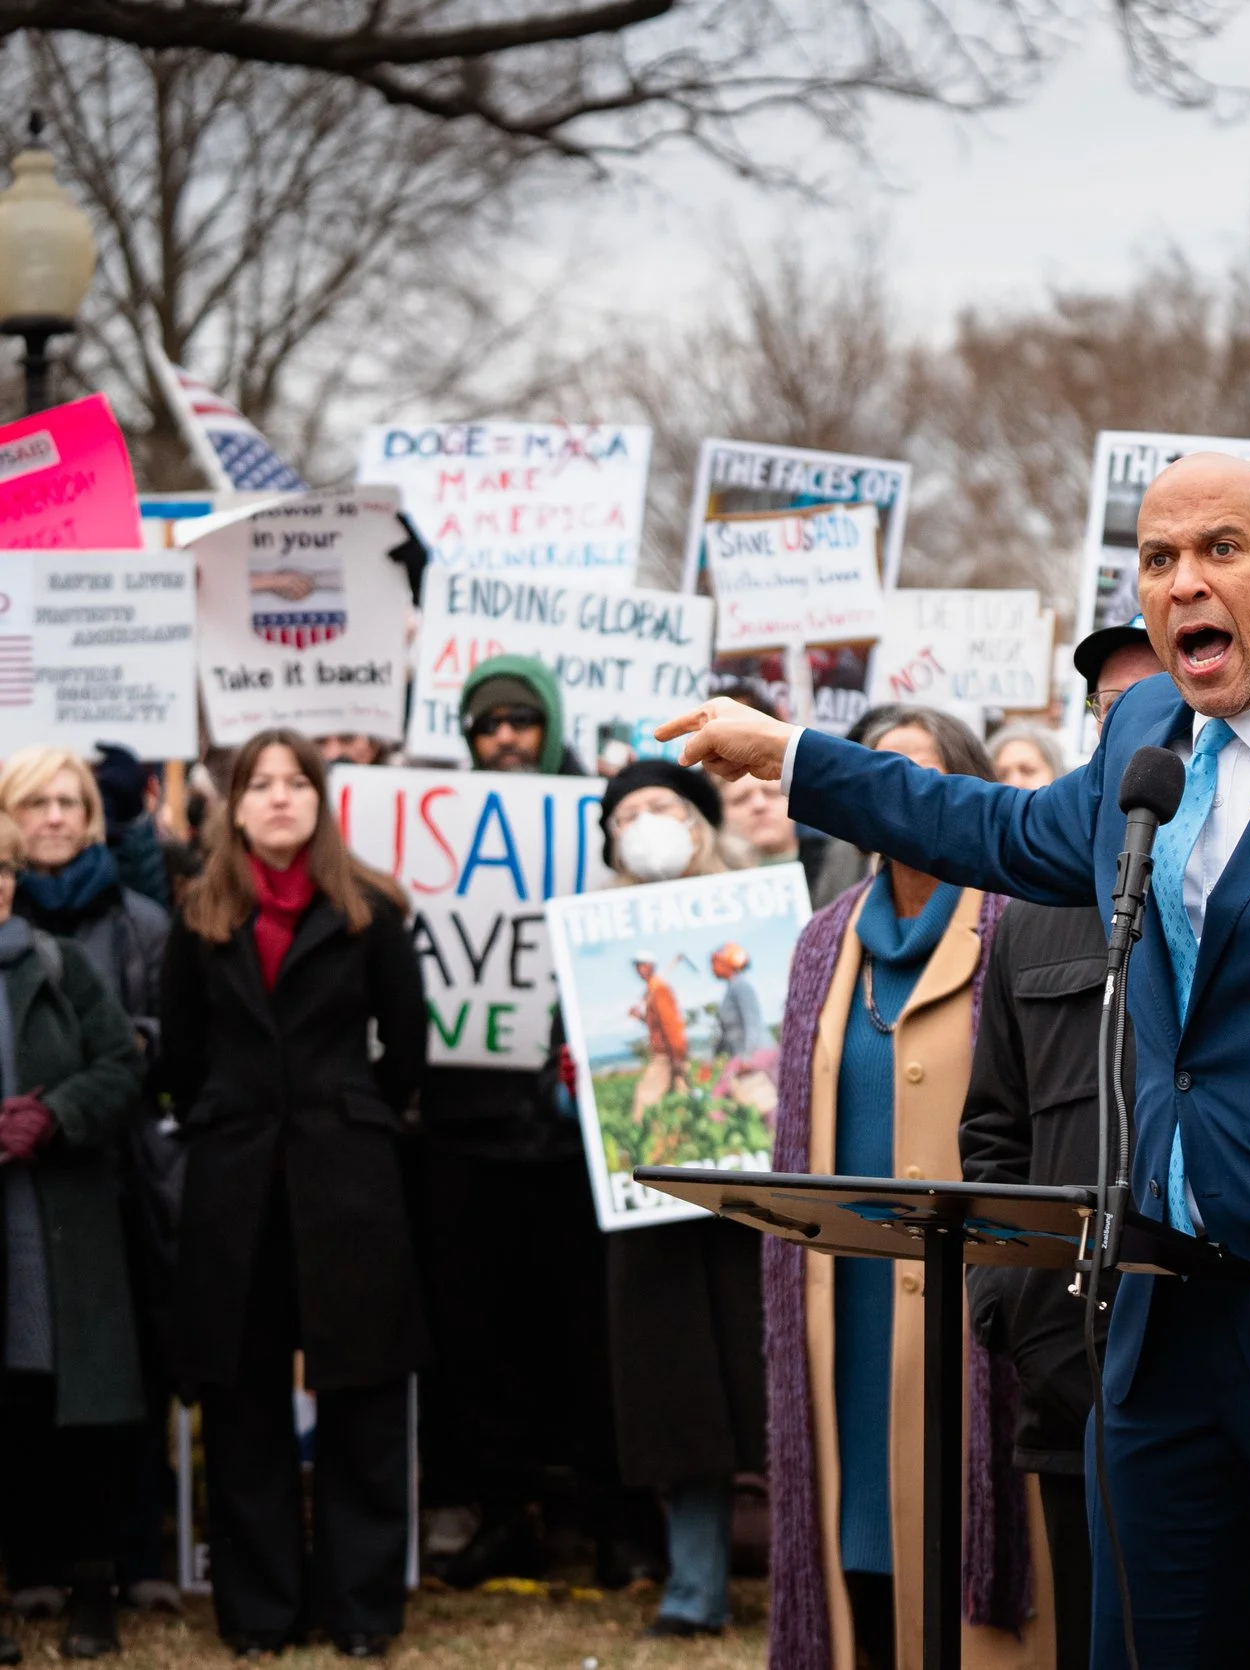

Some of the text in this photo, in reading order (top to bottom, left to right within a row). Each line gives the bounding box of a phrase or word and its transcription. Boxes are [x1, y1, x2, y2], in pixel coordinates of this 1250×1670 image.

[383, 426, 486, 461] DOGE
[437, 467, 543, 504] MAKE
[713, 450, 905, 506] THE FACES OF
[252, 531, 342, 555] in your
[437, 503, 626, 540] AMERICA
[716, 513, 860, 559] SAVE USAID
[448, 573, 694, 647] ENDING GLOBAL
[213, 660, 392, 691] Take it back!
[890, 643, 947, 699] NOT
[565, 876, 798, 943] THE FACES OF
[410, 909, 556, 990] AVE
